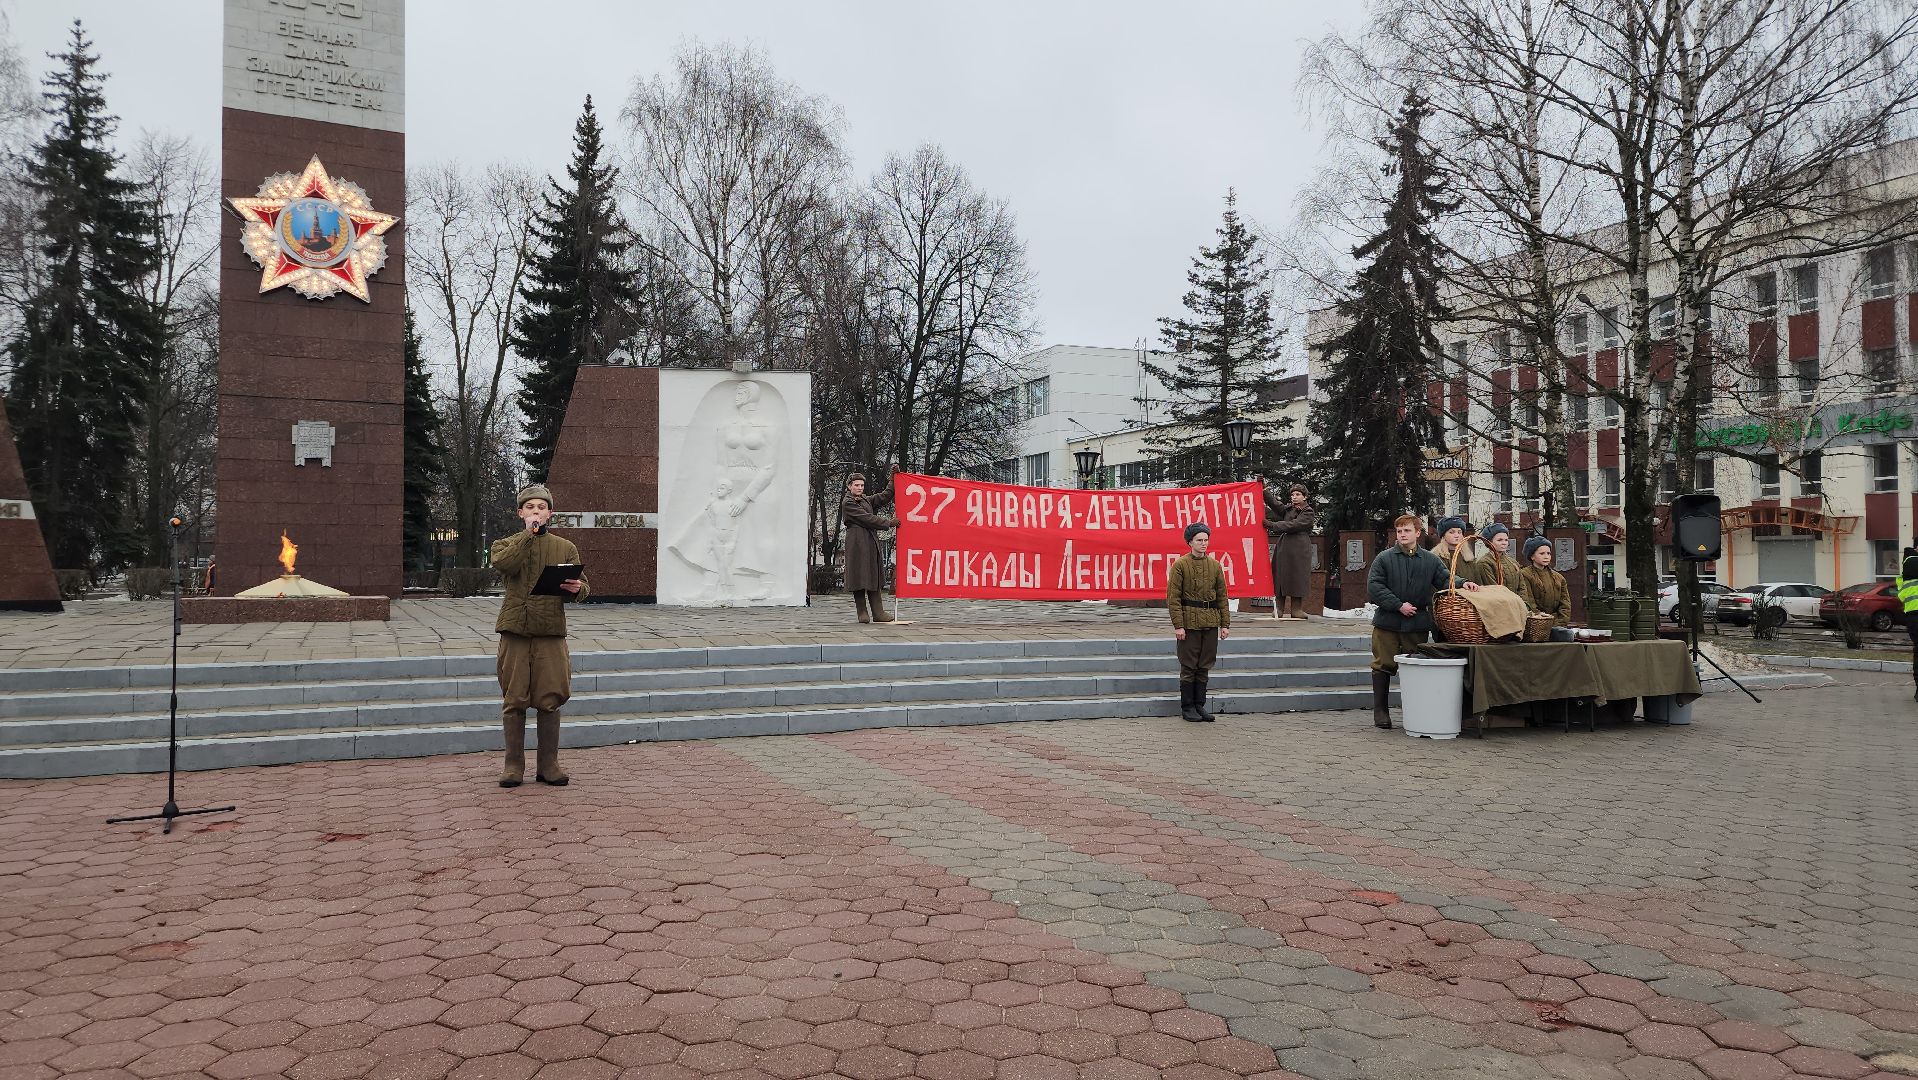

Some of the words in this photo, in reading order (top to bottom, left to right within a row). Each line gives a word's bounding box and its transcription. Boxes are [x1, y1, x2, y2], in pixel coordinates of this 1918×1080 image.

[276, 21, 357, 48] ВЕЧНАЯ
[285, 42, 350, 67] СЛАВА
[246, 57, 385, 92] ЗАЩИТНИКАМ
[254, 78, 383, 111] ОТЕЧЕСТВА
[297, 202, 333, 213] СССР
[546, 514, 583, 528] РЕСТ
[594, 514, 646, 528] МОСКВА
[905, 483, 956, 524] 27
[1157, 491, 1257, 529] СНЯТИЯ
[906, 549, 1041, 589] БЛОКАДЫ
